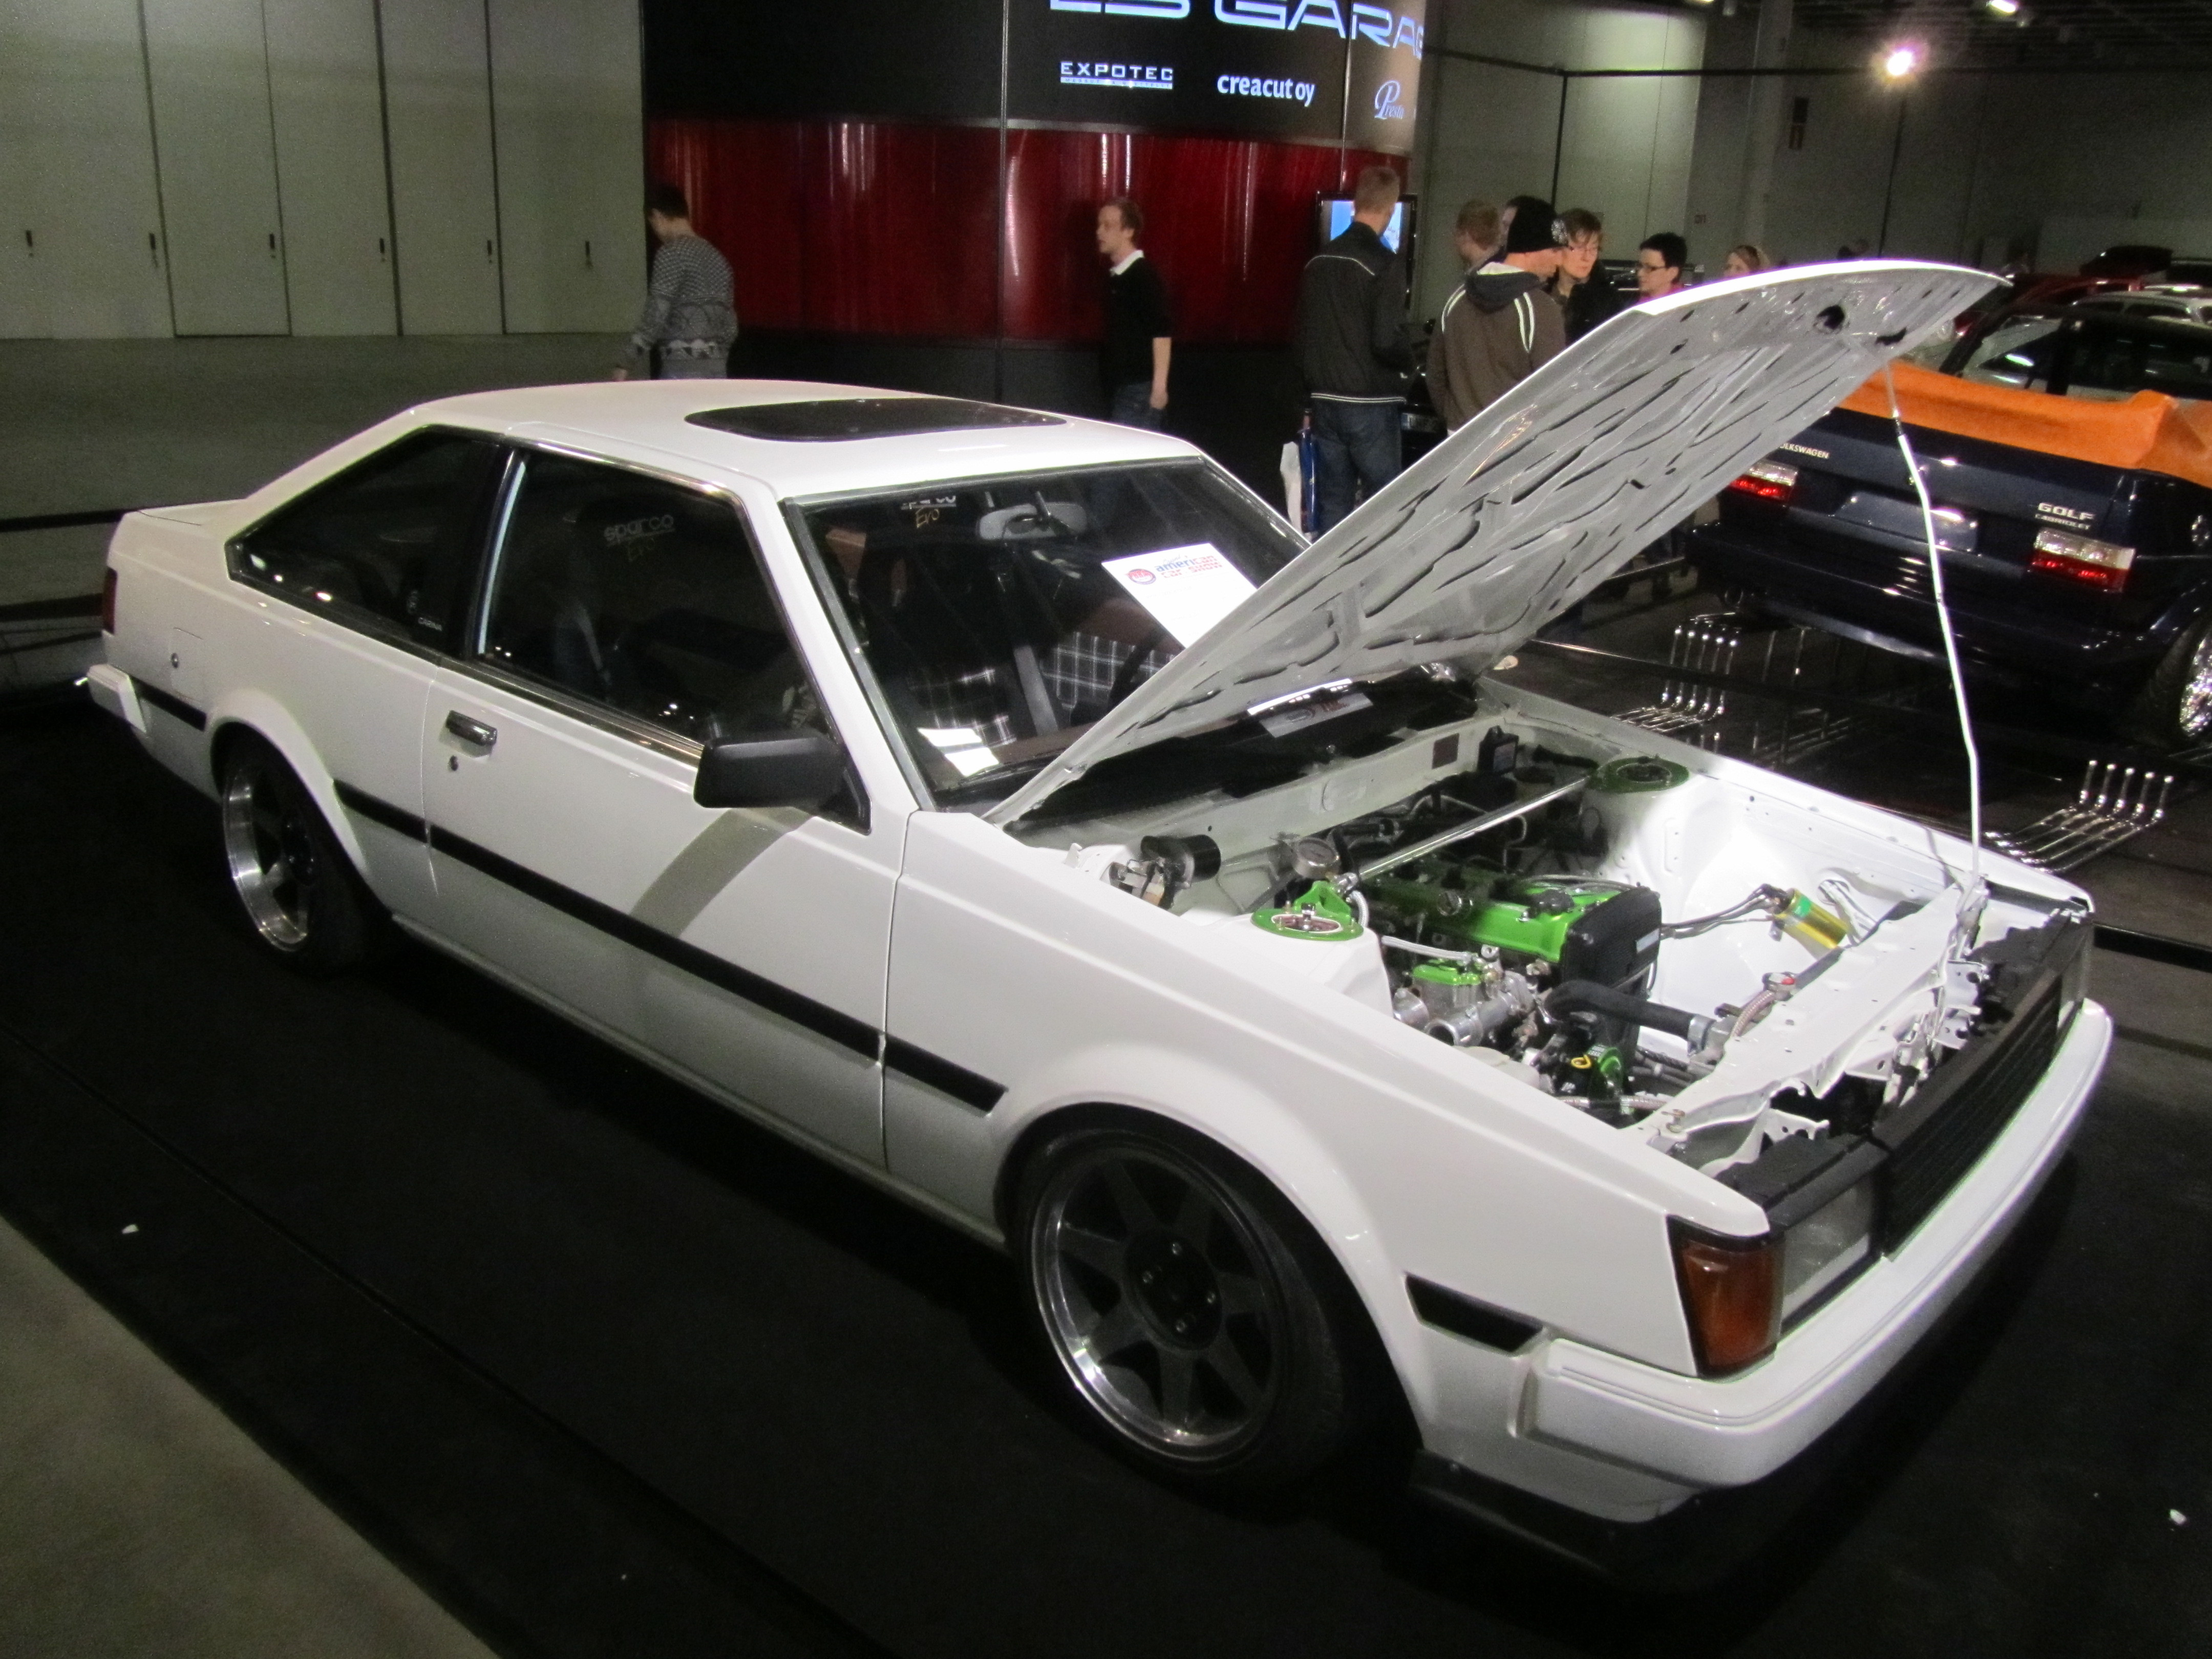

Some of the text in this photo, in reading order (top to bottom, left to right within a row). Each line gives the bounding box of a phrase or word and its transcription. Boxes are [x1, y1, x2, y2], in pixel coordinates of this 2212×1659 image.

[1060, 61, 1173, 81] EXPOTEC
[1217, 75, 1316, 107] creacut oy
[1780, 443, 1830, 459] LKSWAGEN
[2038, 502, 2095, 520] GOLF
[604, 514, 674, 544] sparco
